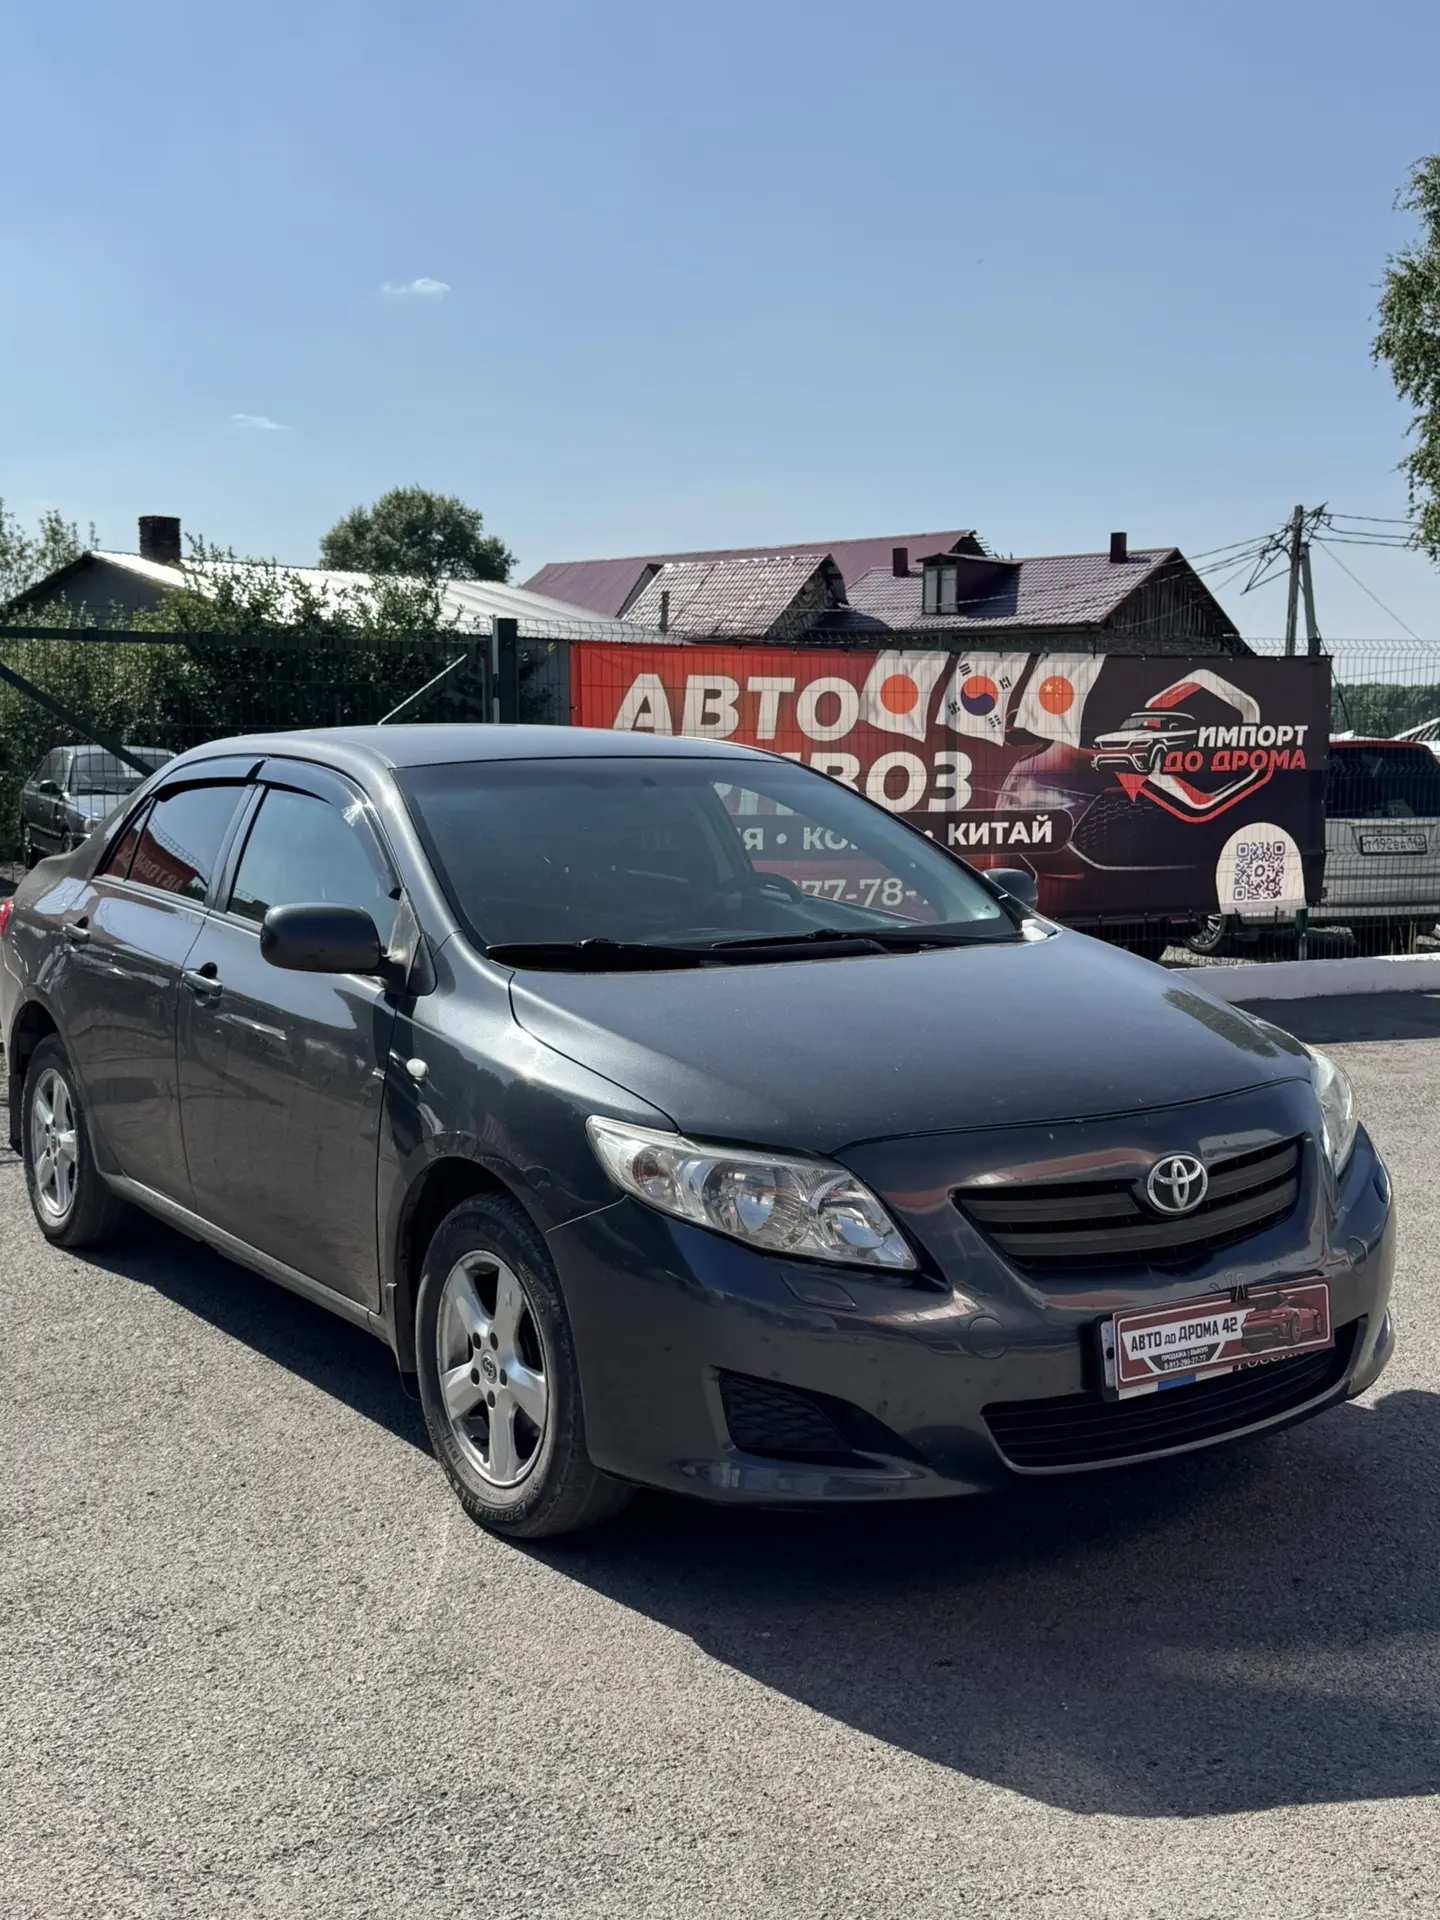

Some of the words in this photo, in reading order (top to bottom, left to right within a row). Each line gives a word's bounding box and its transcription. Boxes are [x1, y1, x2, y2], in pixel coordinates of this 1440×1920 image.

[612, 672, 860, 741] АВТО
[1197, 725, 1308, 748] ИМПОРТ
[1163, 750, 1203, 772] ДО
[1211, 749, 1307, 772] ДРОМА
[947, 814, 1053, 847] КИТАЙ
[1131, 1331, 1163, 1352] АВТО
[1178, 1321, 1219, 1343] ДРОМА
[1222, 1316, 1238, 1333] 42
